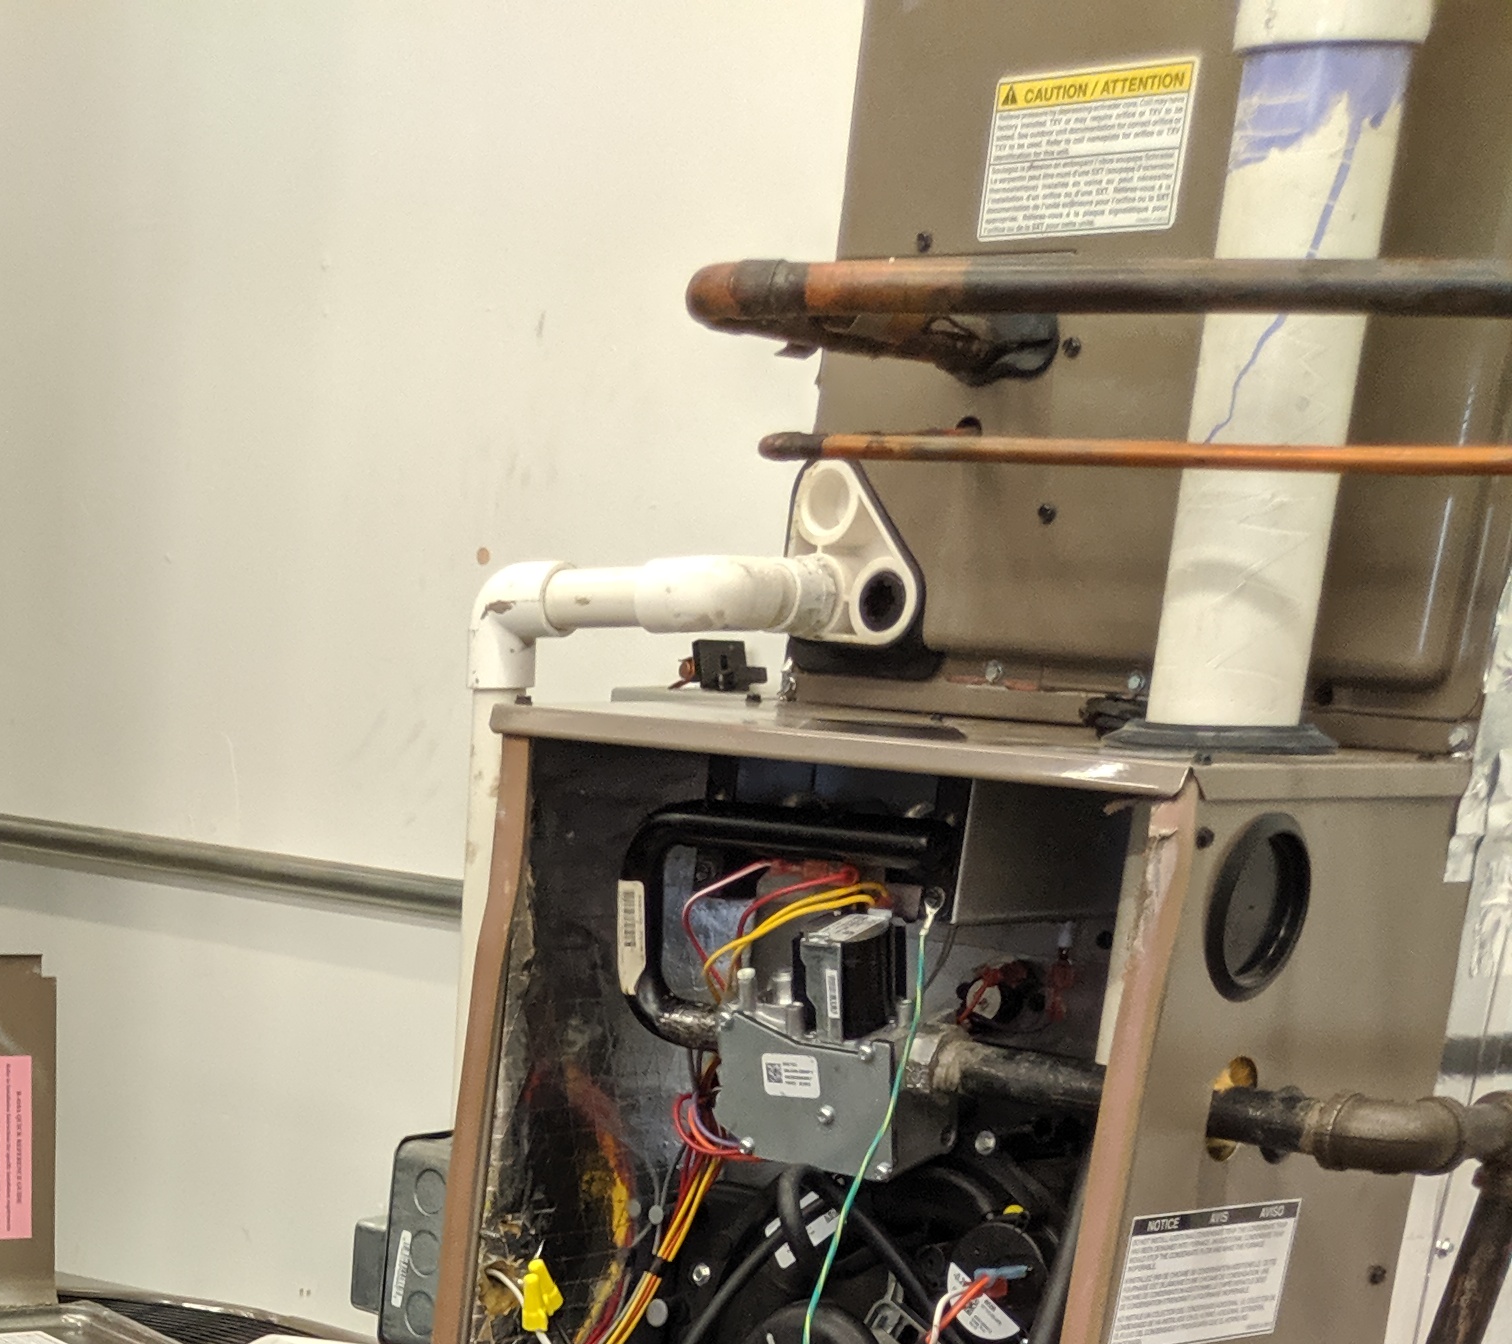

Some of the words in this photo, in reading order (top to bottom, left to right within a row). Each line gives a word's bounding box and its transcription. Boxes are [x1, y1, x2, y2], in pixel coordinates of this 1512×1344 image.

[1024, 83, 1089, 104] CAUTION
[1100, 72, 1186, 95] ATTENTION
[1208, 1210, 1229, 1224] AVIS
[1258, 1204, 1285, 1218] AVISO
[1146, 1217, 1180, 1232] NOTICE
